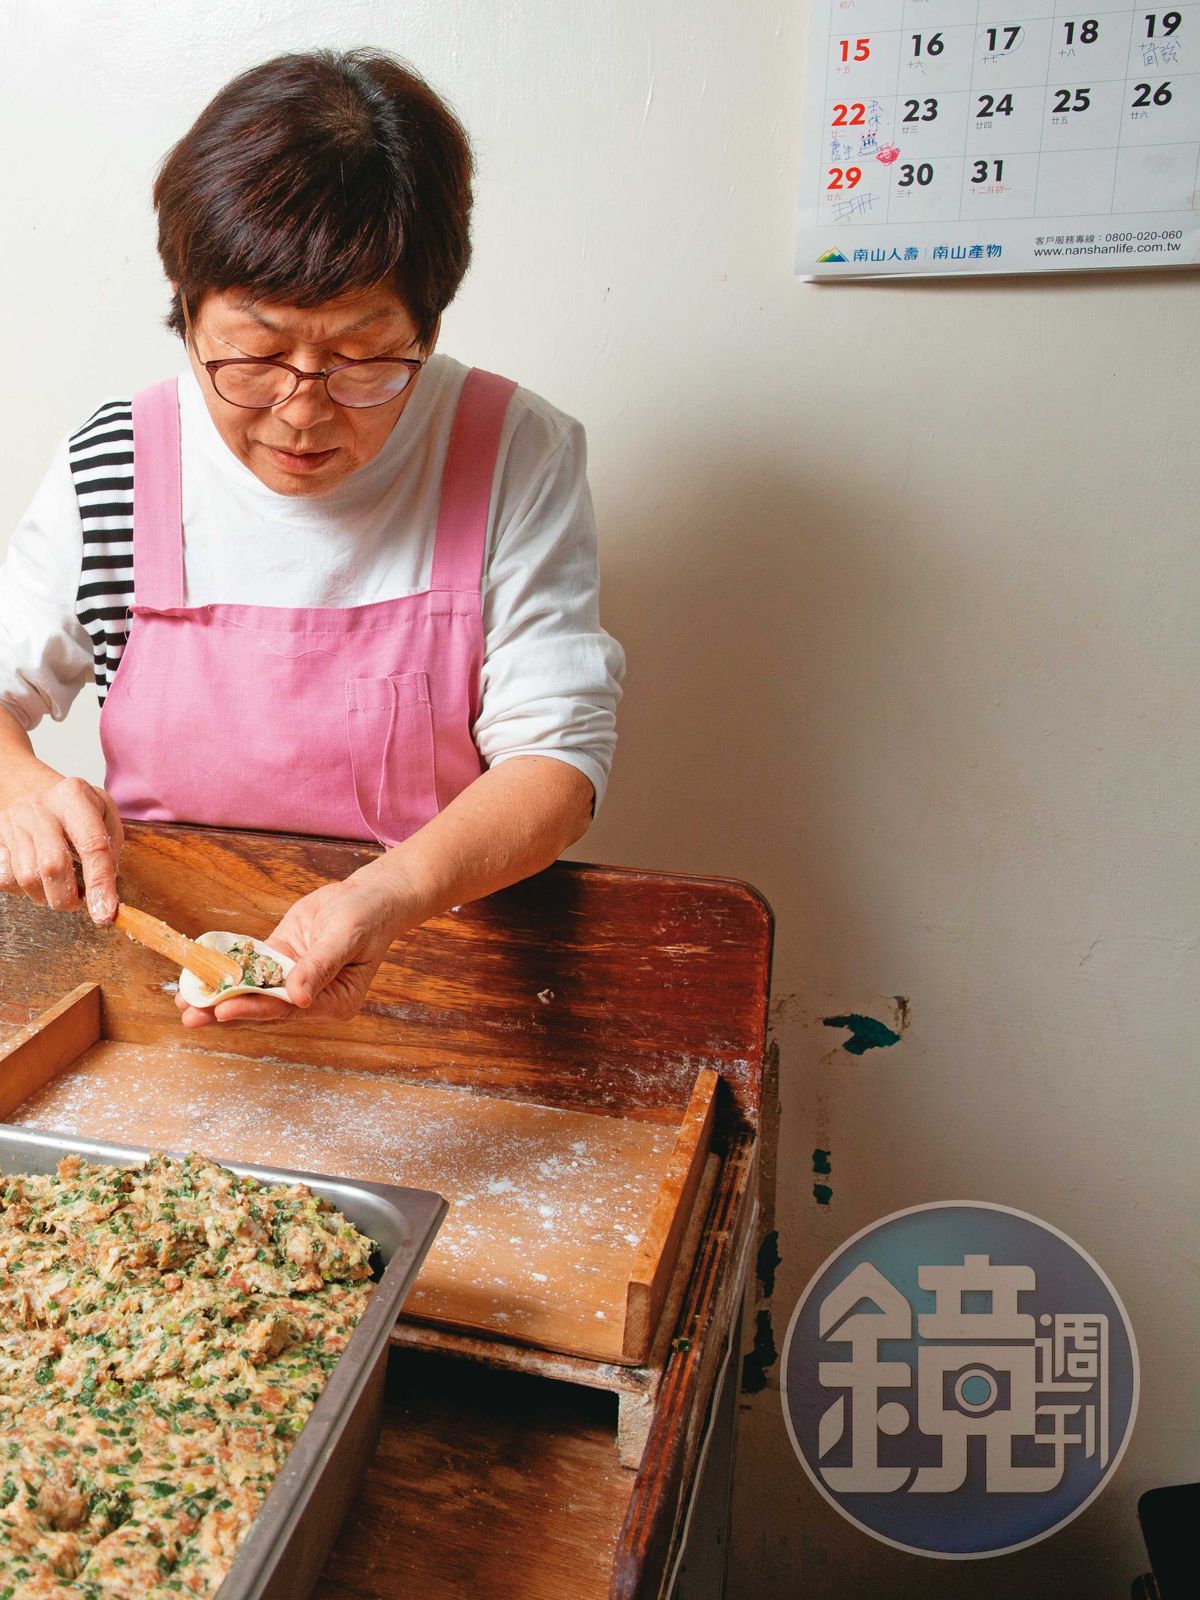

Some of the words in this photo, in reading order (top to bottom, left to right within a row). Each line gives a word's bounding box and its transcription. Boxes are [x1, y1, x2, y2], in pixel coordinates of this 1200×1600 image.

[839, 38, 871, 62] 15
[911, 33, 944, 56] 16
[987, 26, 1021, 51] 17
[1064, 19, 1099, 45] 18
[1145, 12, 1182, 38] 19
[834, 66, 851, 74] 十五
[906, 60, 924, 69] 十六
[980, 55, 998, 64] 十七
[1058, 49, 1076, 57] 十八
[831, 103, 865, 127] 22
[902, 98, 938, 122] 23
[976, 94, 1014, 118] 24
[1052, 88, 1091, 113] 25
[1131, 82, 1172, 107] 26
[902, 125, 918, 134] 廿三
[976, 121, 992, 129] 廿四
[1052, 116, 1069, 125] 廿五
[1130, 111, 1149, 120] 廿六
[827, 167, 862, 190] 29
[898, 163, 934, 187] 30
[971, 160, 1004, 183] 31
[896, 189, 913, 198] 三十
[853, 247, 919, 263] 南山人壽
[932, 244, 1003, 260] 南山產物
[1034, 242, 1182, 257] www.nanshanlife.com.tw
